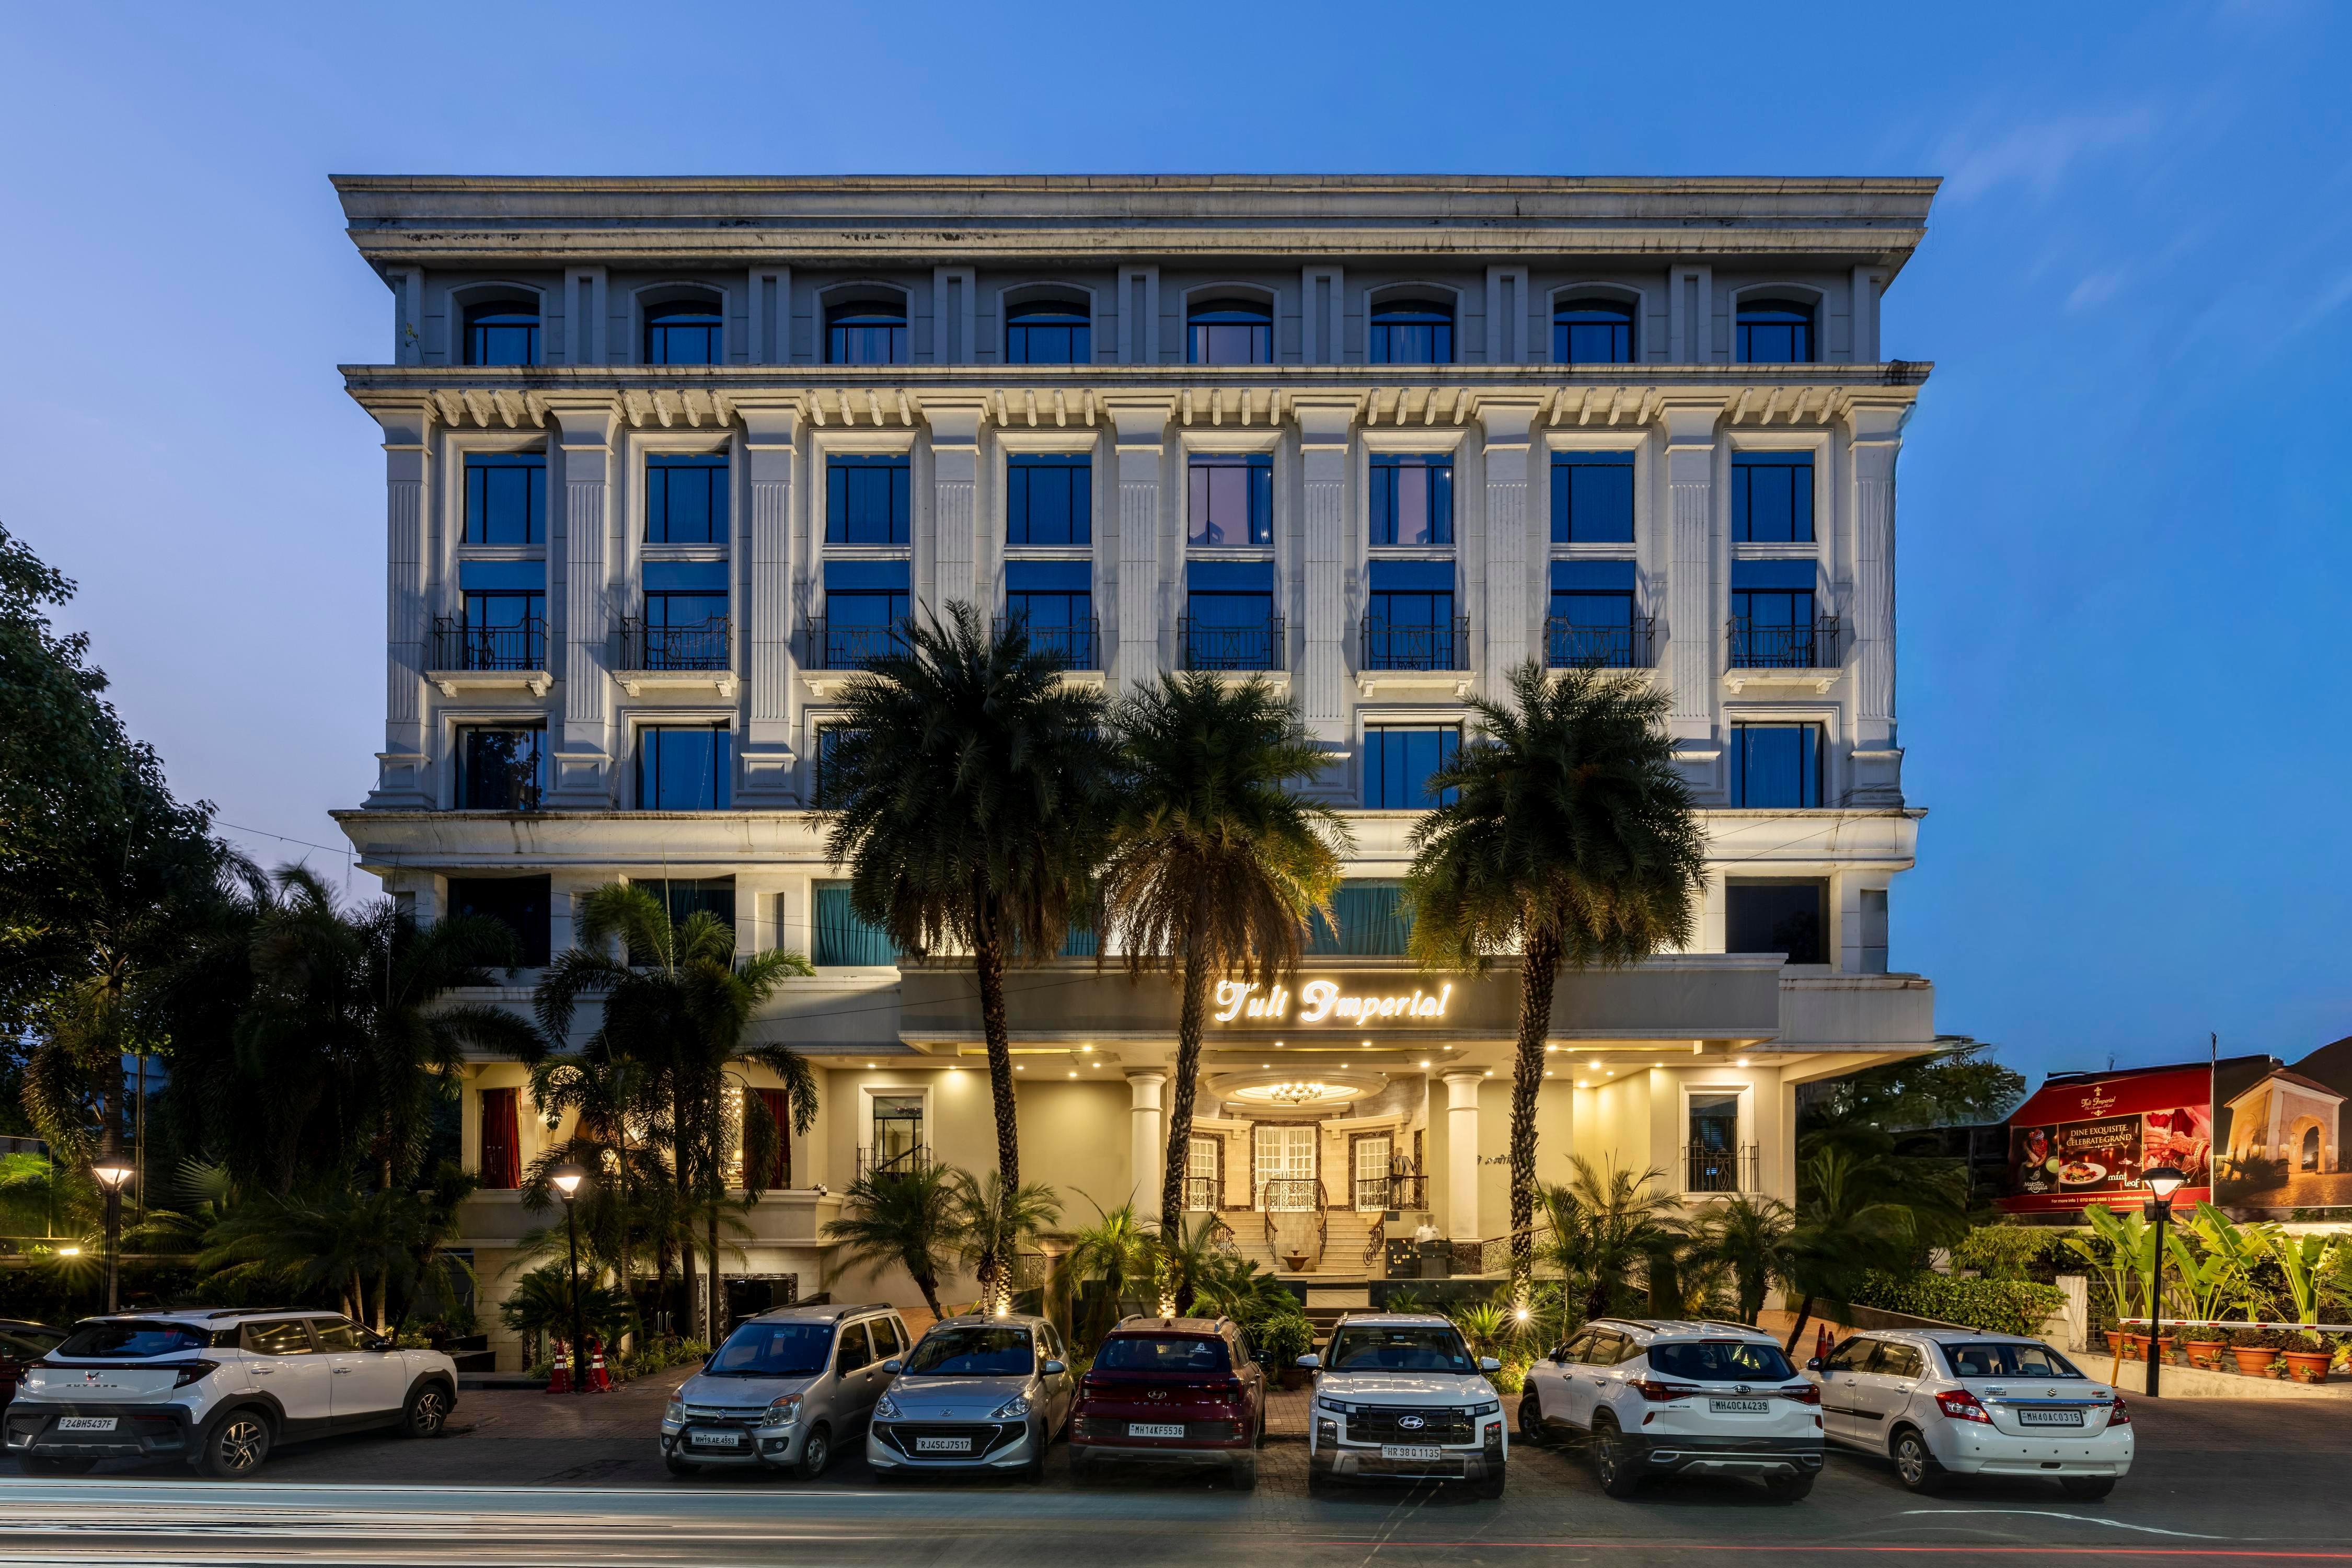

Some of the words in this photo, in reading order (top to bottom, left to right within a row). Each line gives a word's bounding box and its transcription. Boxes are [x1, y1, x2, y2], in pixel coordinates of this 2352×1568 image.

[1215, 979, 1288, 1022] Tuli
[1300, 979, 1452, 1025] Imperial
[2081, 1098, 2092, 1108] Tuli
[2092, 1096, 2116, 1105] Imperial
[2070, 1128, 2089, 1137] DINE
[2090, 1124, 2129, 1135] EXQUISITE.
[2066, 1136, 2103, 1147] CELEBRATE
[2104, 1133, 2134, 1143] GRAND.
[2107, 1171, 2127, 1181] mint
[2027, 1183, 2048, 1193] Masala
[2124, 1178, 2140, 1188] leaf
[1715, 1401, 1768, 1410] MH40CA4239
[2027, 1413, 2080, 1421] MH40AC0315
[65, 1420, 112, 1428] 24BH5437F
[1135, 1426, 1183, 1435] MH14KF5536
[1388, 1447, 1398, 1456] HR
[1400, 1448, 1410, 1456] 98
[1419, 1449, 1439, 1458] 1135
